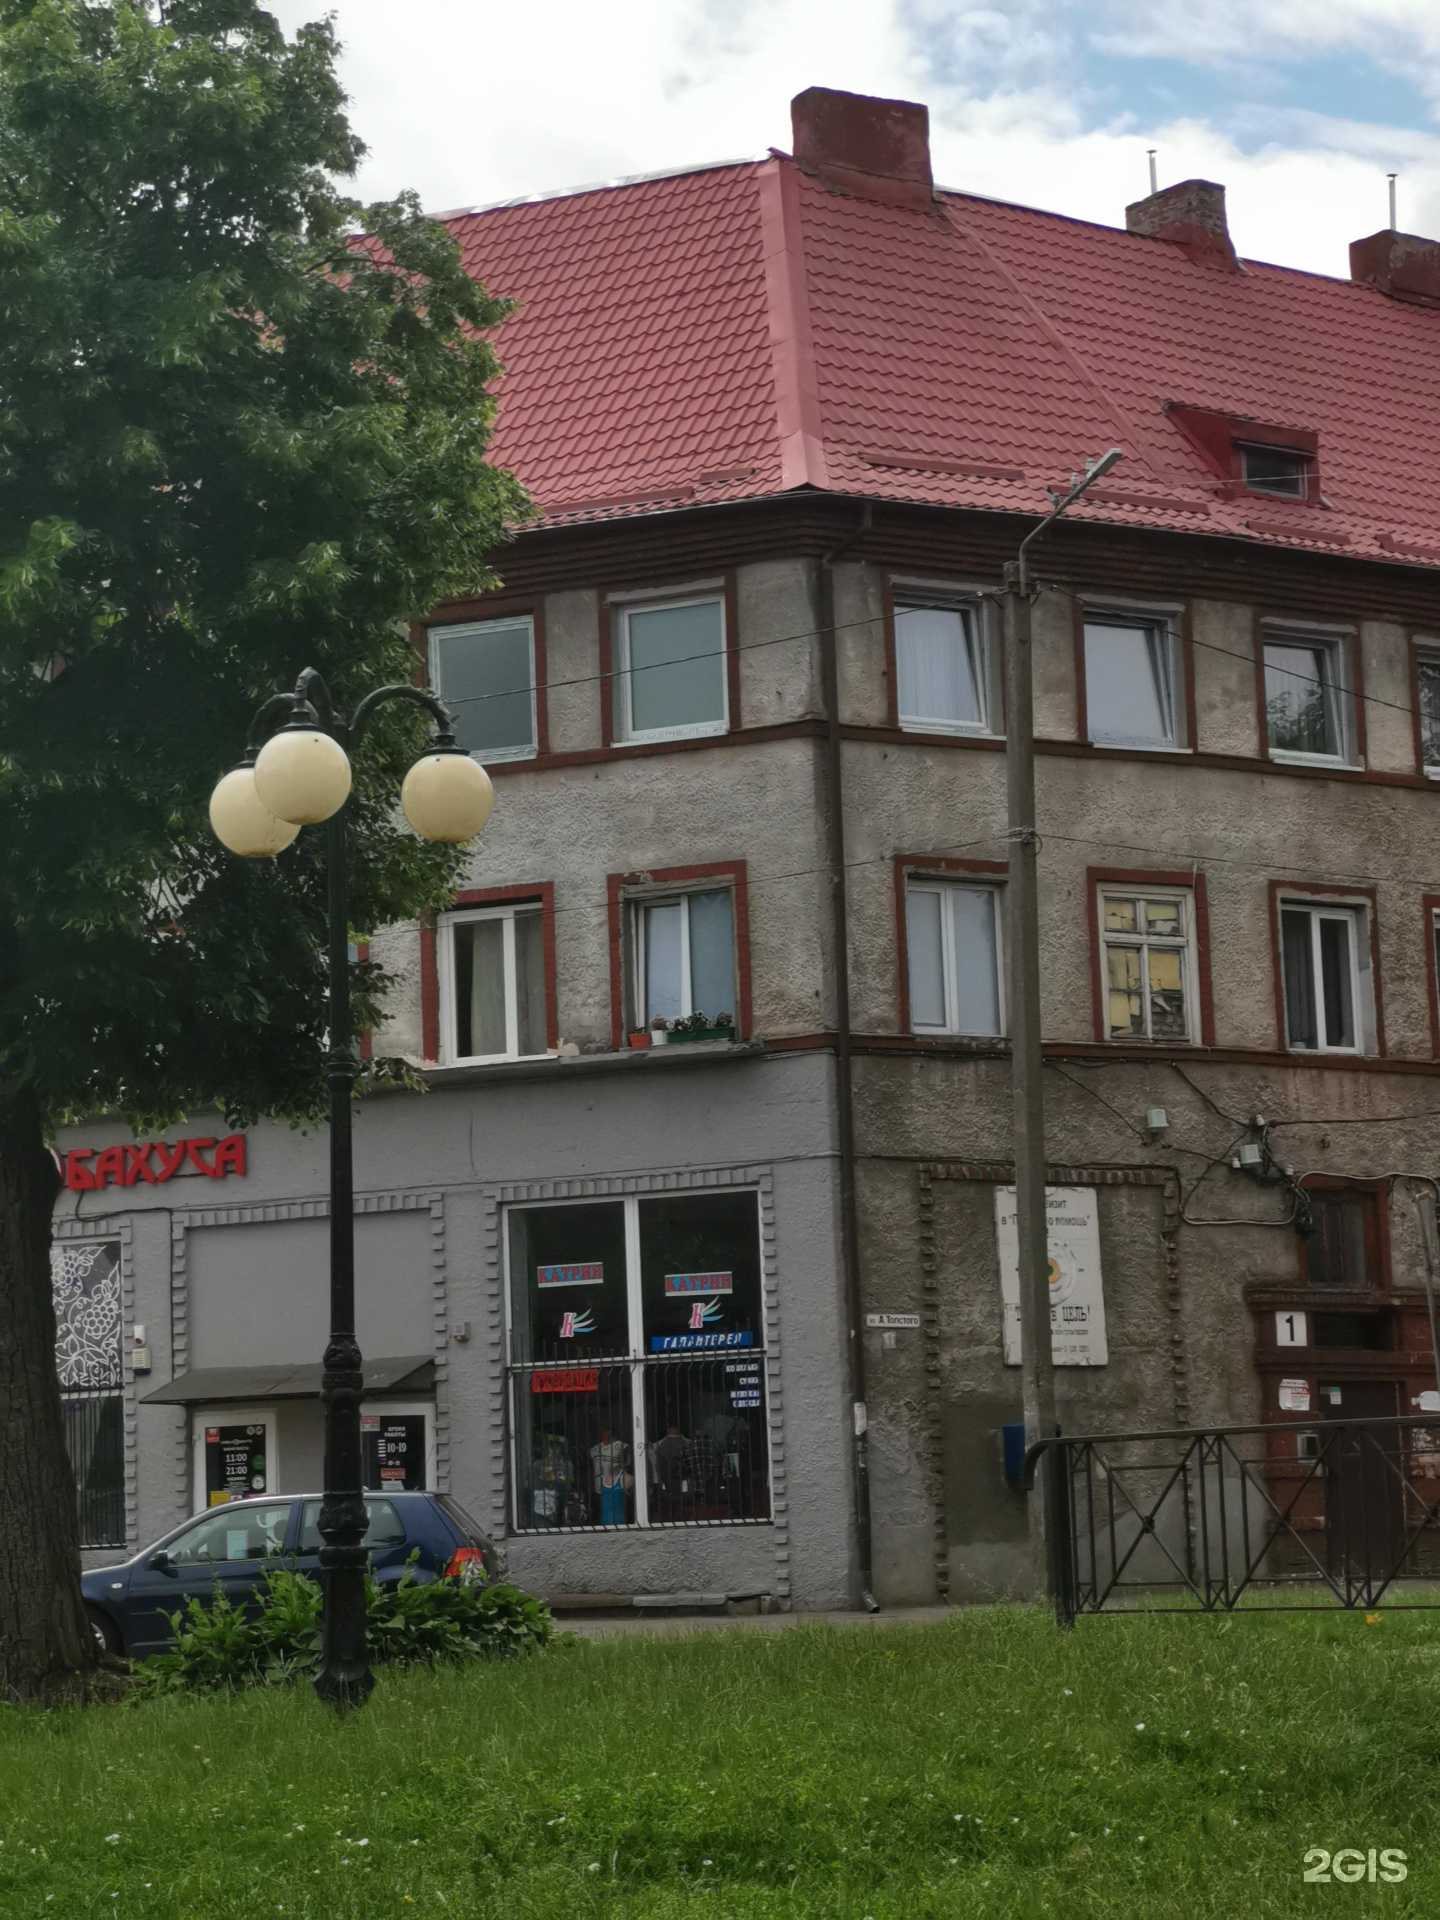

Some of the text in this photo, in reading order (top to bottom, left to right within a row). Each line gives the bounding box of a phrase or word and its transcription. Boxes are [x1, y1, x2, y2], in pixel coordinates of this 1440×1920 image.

[67, 1134, 247, 1191] БАХУСА
[1285, 1314, 1295, 1342] 1
[663, 1332, 742, 1349] ГАЛАНТЕРЕЯ
[225, 1453, 248, 1463] 11:00
[225, 1466, 248, 1476] 21:00
